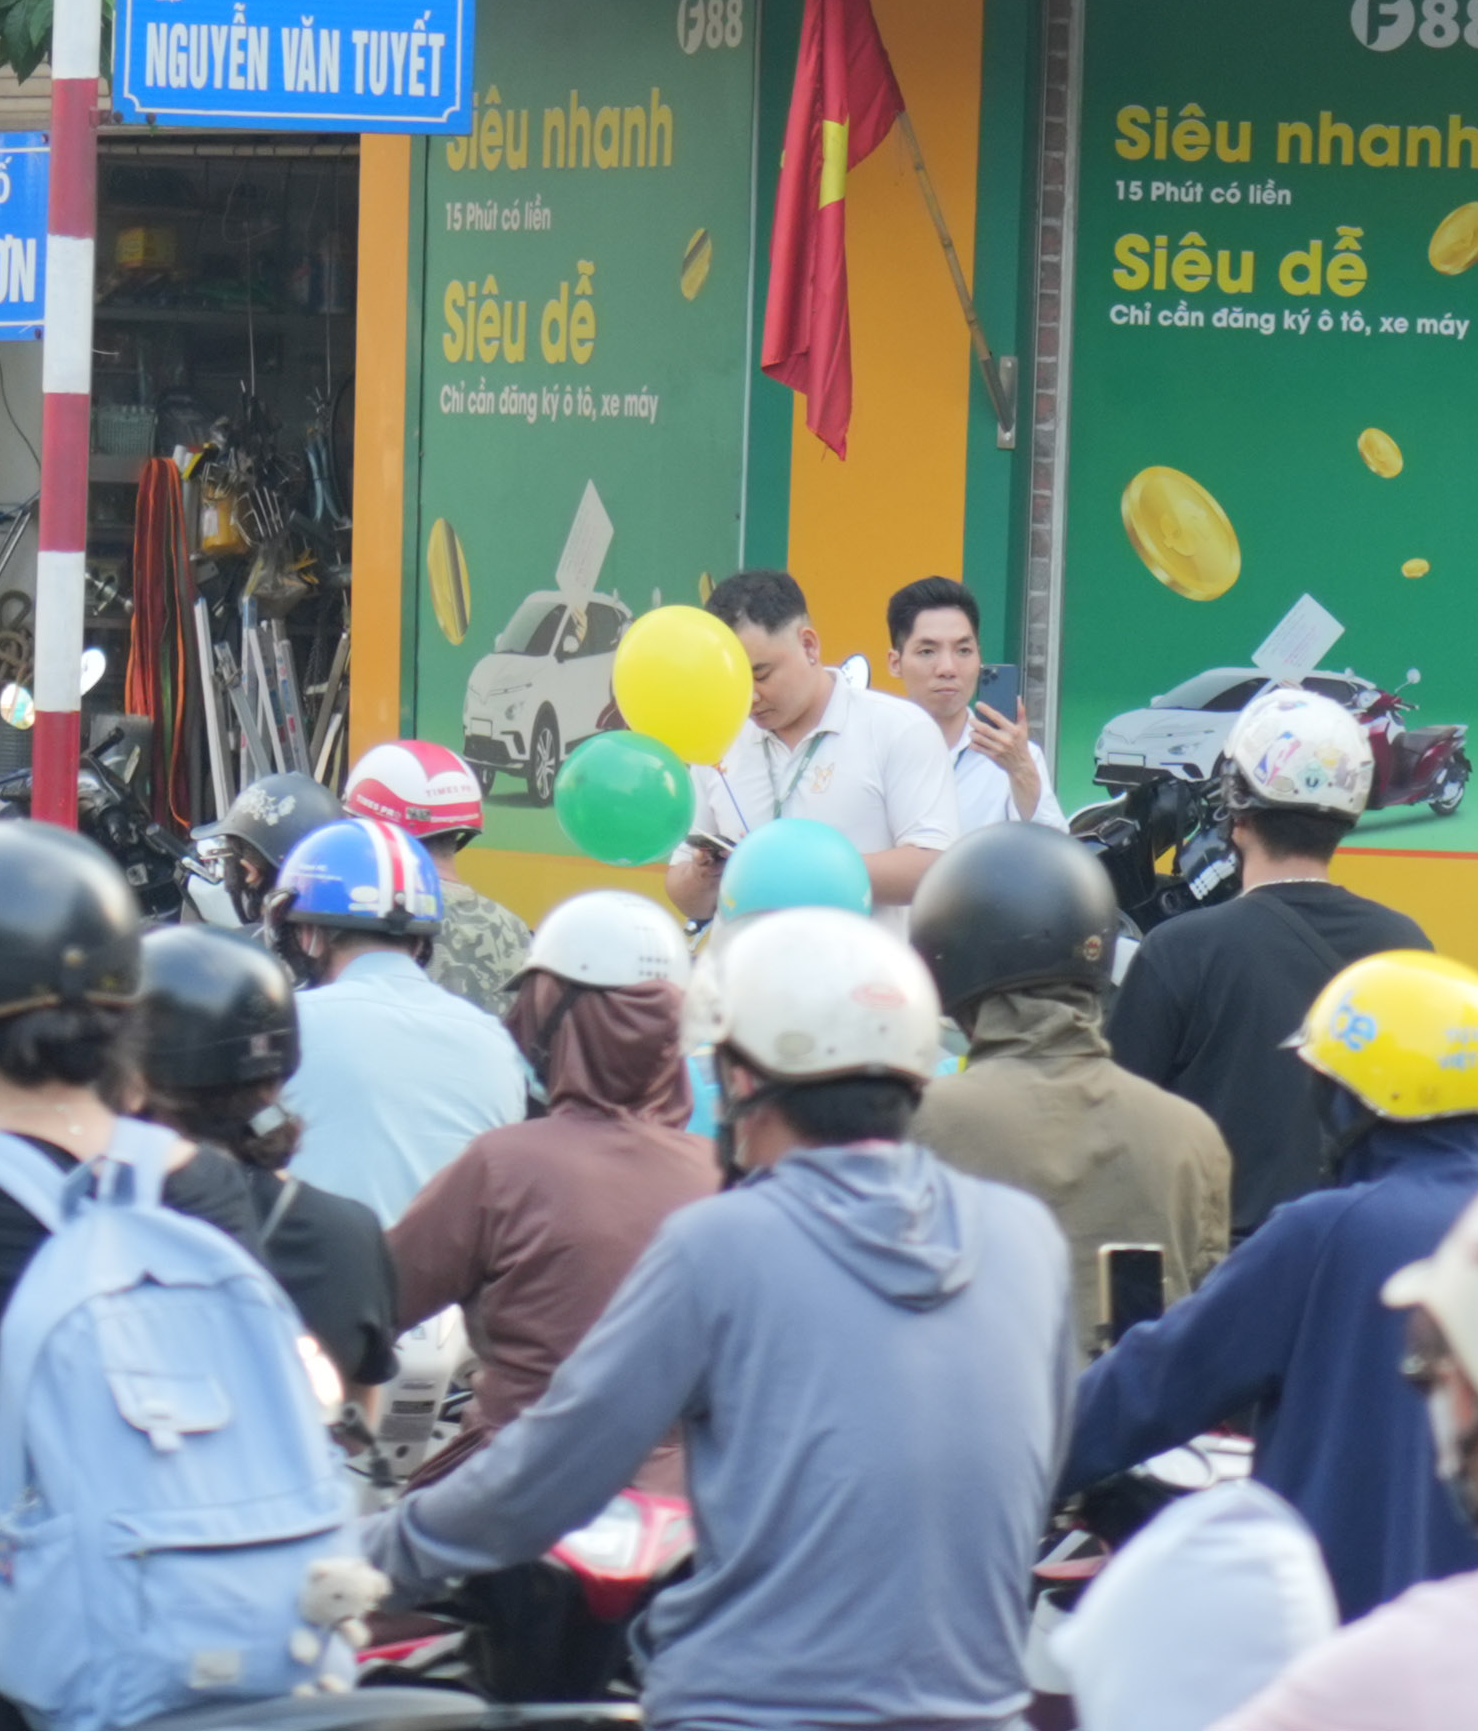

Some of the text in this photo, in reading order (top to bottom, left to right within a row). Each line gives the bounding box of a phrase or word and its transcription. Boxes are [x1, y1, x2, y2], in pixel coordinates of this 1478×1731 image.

[145, 4, 445, 96] NGUYỄN VĂN TUYẾT
[542, 87, 673, 167] nhanh
[1115, 103, 1251, 162] Siêu
[1115, 178, 1291, 205] 15 Phút có liền
[1113, 226, 1368, 297] Siêu dễ
[442, 260, 596, 364] Siêu dễ
[1110, 300, 1470, 340] Chỉ cần đăng ký ô tô, xe máy
